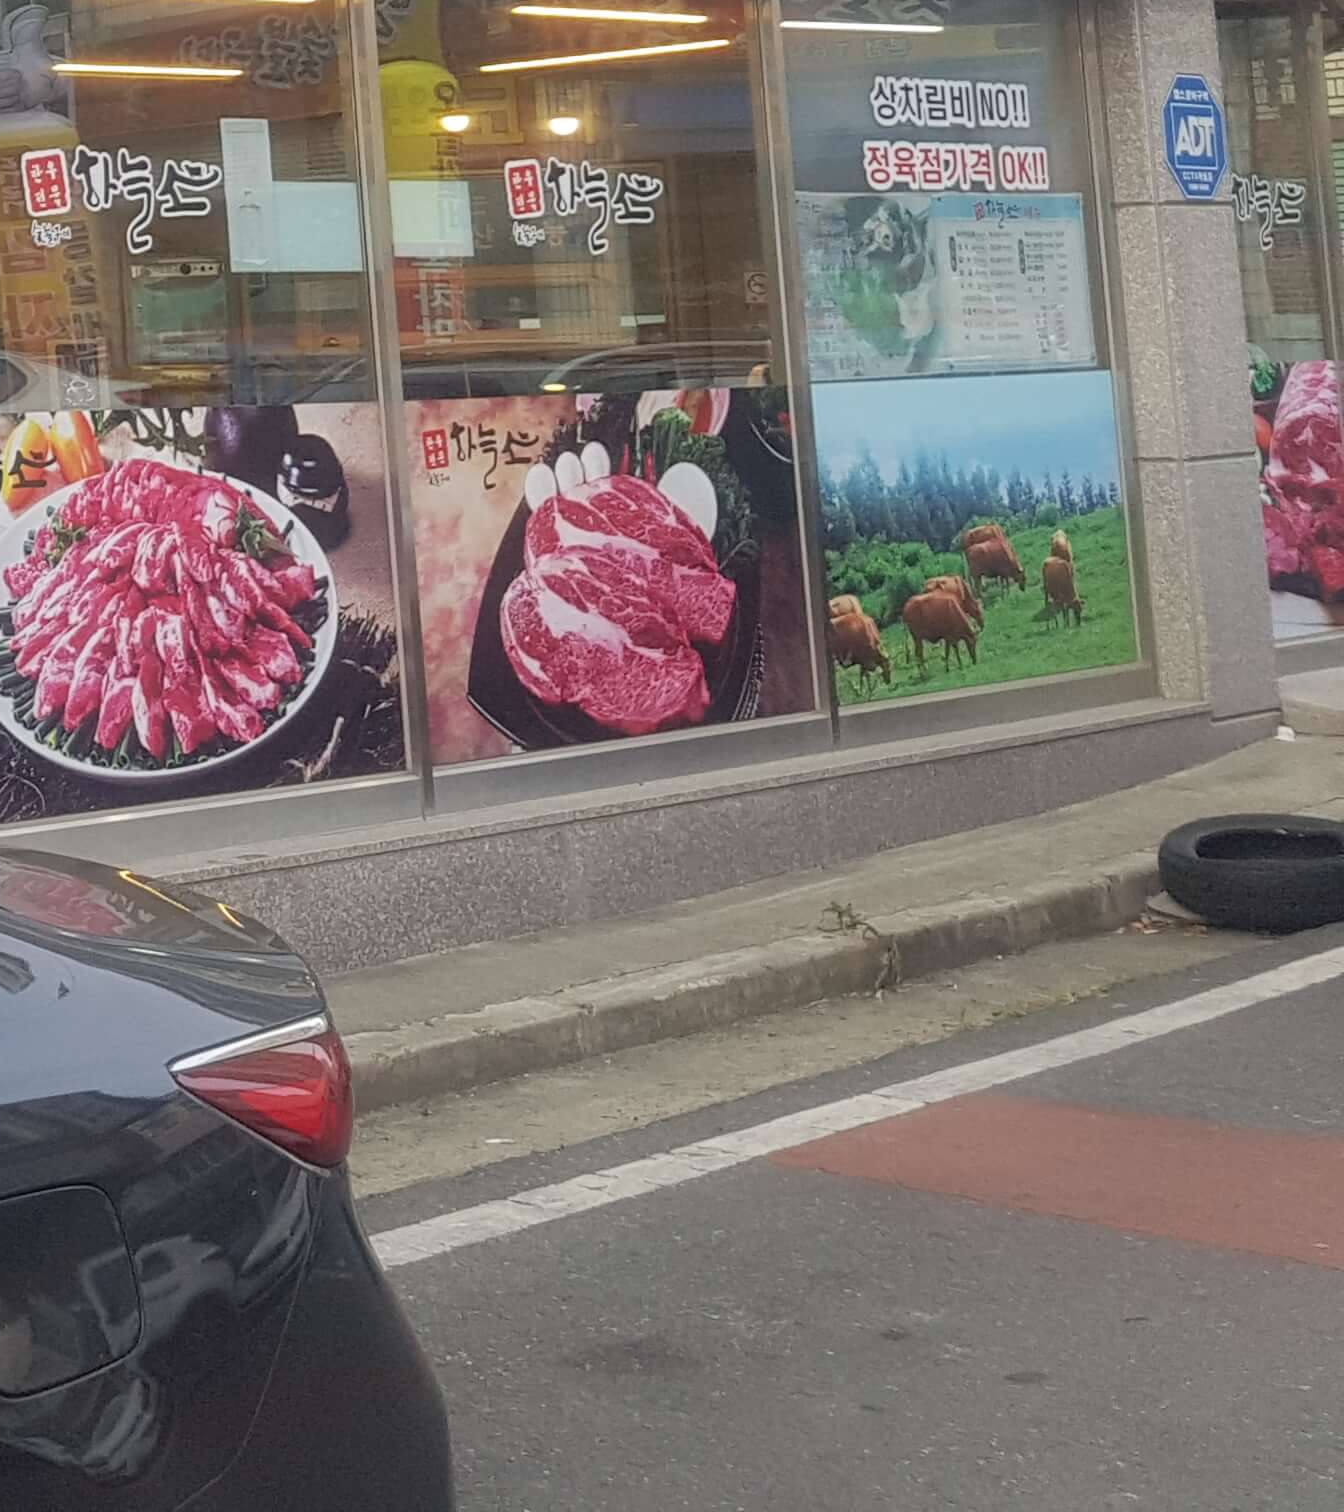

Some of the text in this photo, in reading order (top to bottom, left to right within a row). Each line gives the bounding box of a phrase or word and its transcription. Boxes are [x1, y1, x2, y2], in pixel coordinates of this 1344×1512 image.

[869, 75, 977, 129] 상차림비
[863, 141, 994, 190] 정육점가격
[1174, 115, 1216, 158] ADT
[72, 144, 222, 253] 하늘소
[545, 157, 662, 255] 하늘소
[451, 422, 540, 490] 하늘소
